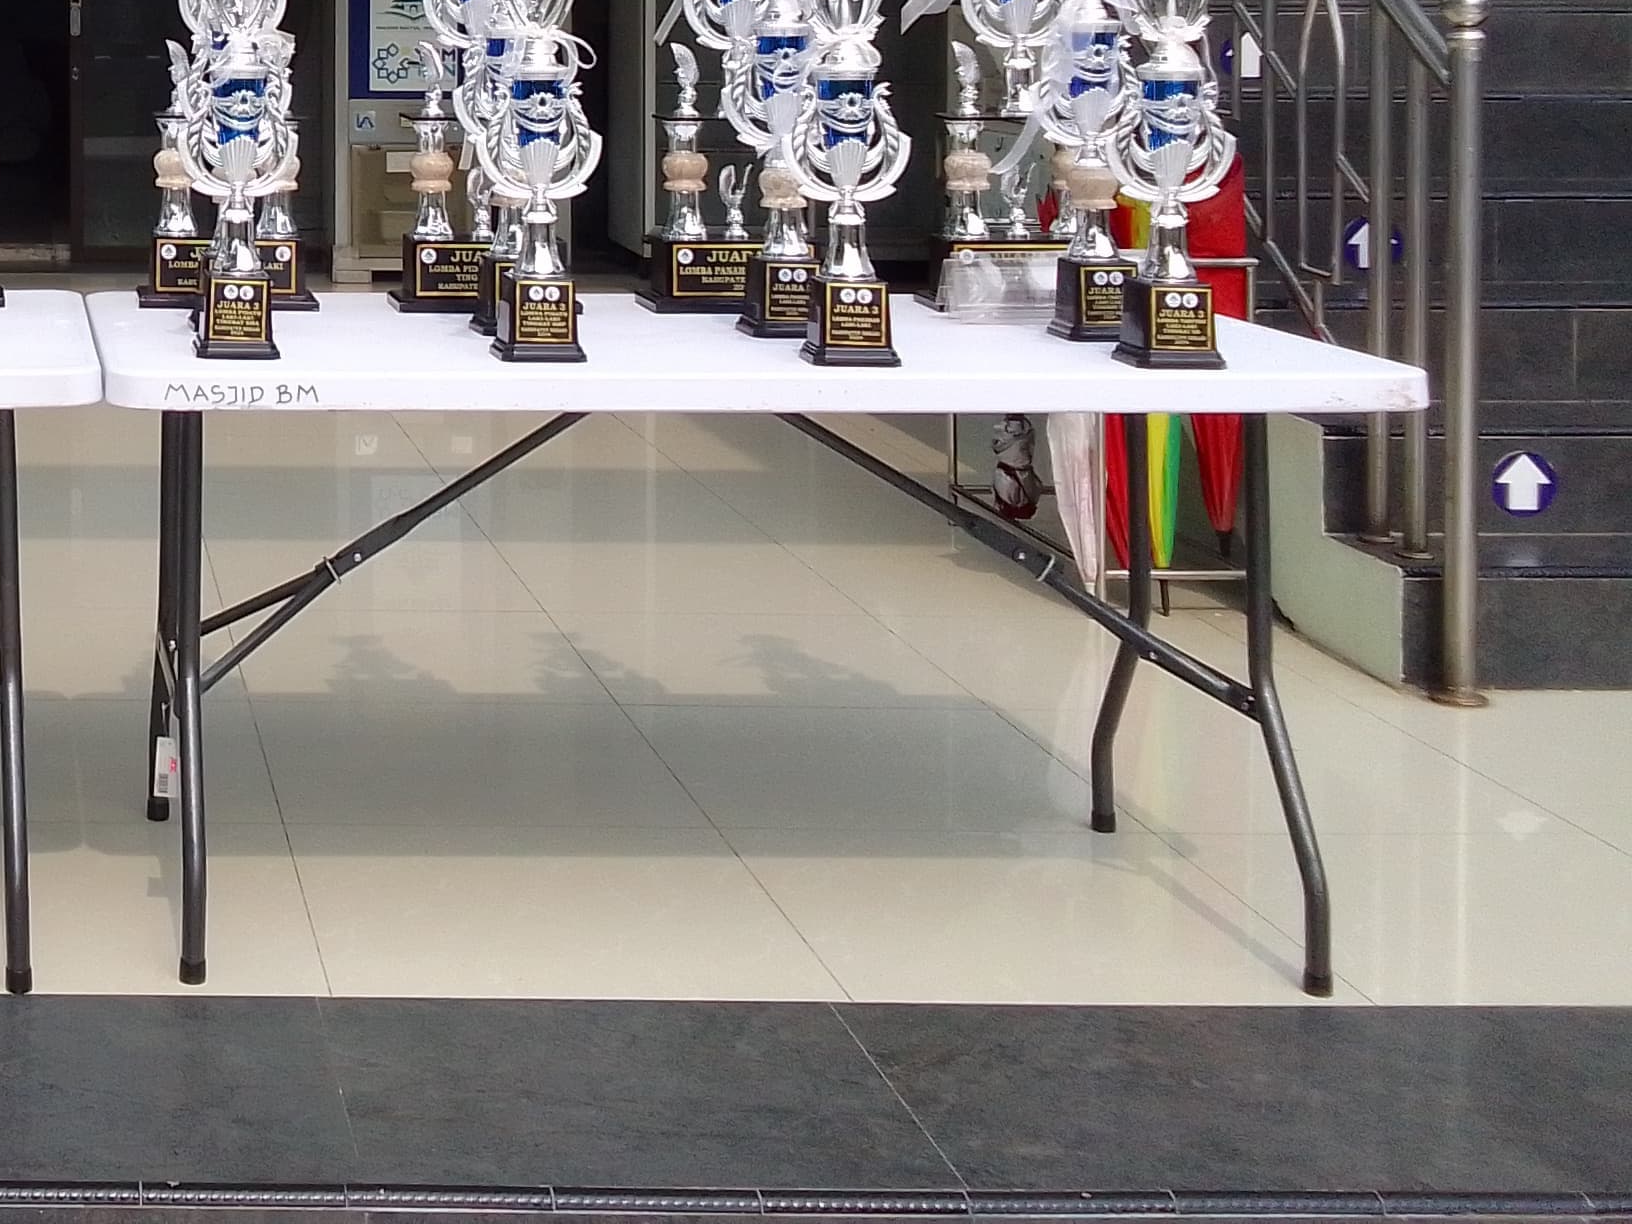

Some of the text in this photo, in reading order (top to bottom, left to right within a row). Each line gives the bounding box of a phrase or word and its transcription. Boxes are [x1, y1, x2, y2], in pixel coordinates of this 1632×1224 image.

[451, 251, 482, 262] JUA
[680, 266, 713, 275] LOMBA
[773, 283, 804, 291] JUARA
[217, 301, 250, 309] JUARA
[559, 303, 566, 311] 3
[872, 306, 878, 314] 3
[1159, 309, 1195, 317] JUARA
[164, 384, 319, 407] MASJID BM
